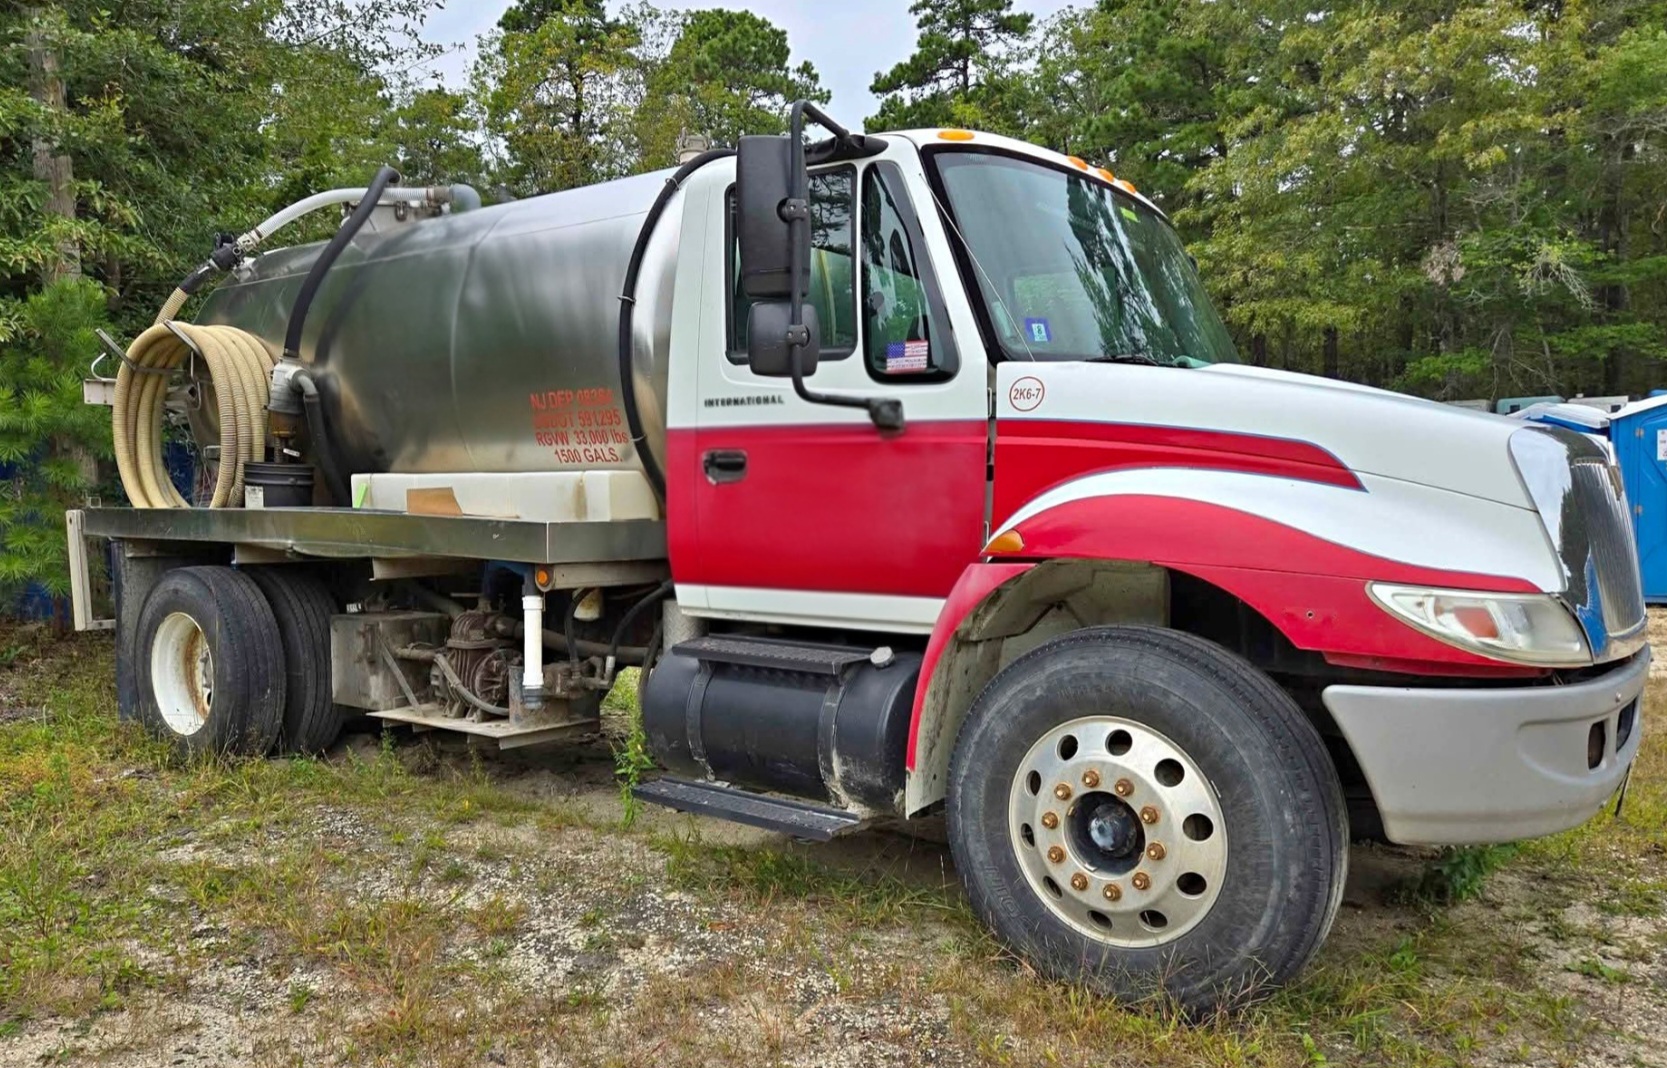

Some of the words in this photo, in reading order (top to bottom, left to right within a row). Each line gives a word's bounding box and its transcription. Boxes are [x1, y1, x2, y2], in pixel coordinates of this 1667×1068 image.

[530, 393, 546, 410] NJ
[704, 395, 785, 407] INTERNATIONAL
[1013, 387, 1041, 400] 2K6-7
[577, 407, 622, 427] 591295
[535, 430, 570, 446] RGVW
[573, 428, 609, 447] 33,000
[610, 428, 629, 444] lbs
[554, 448, 582, 464] 1500
[583, 446, 623, 463] GALS.
